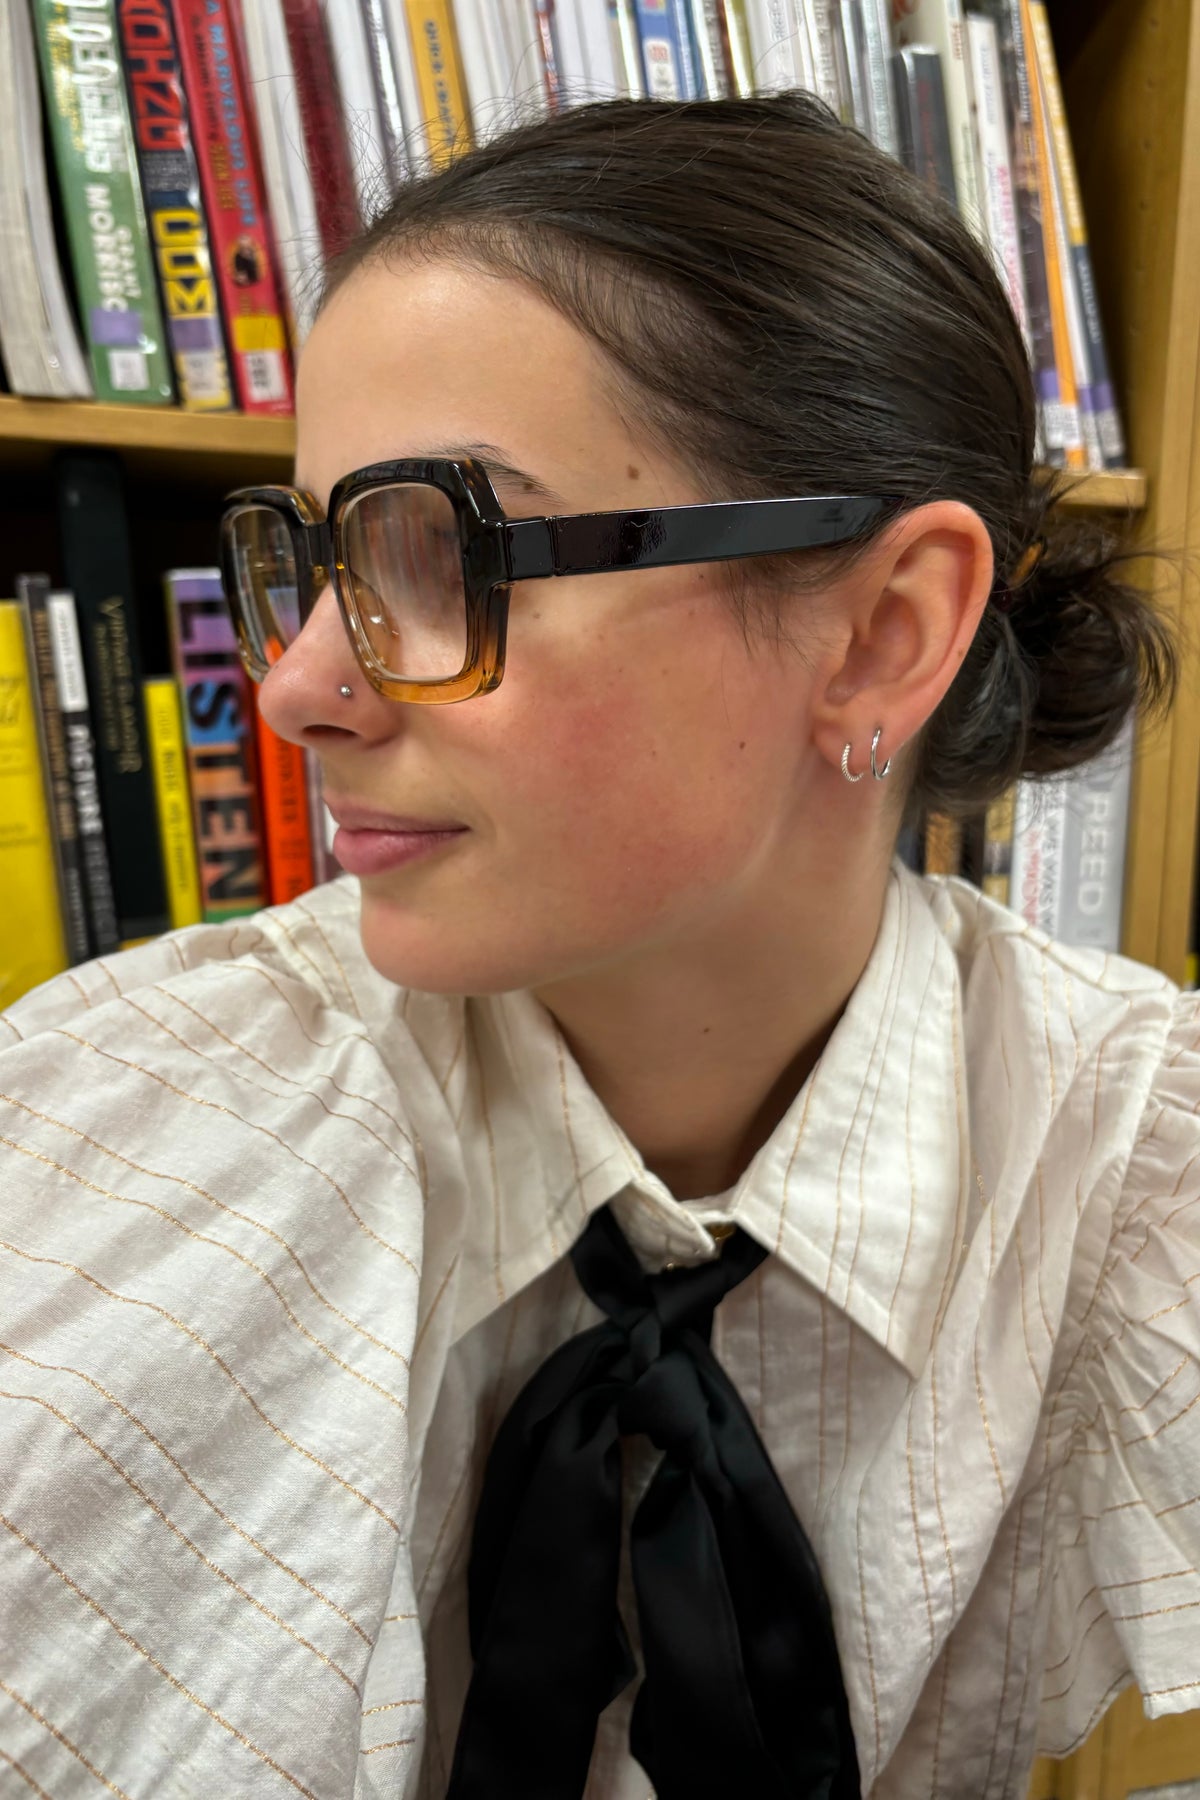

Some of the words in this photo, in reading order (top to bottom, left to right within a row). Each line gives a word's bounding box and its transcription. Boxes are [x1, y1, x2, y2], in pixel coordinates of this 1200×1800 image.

[209, 24, 249, 171] MARVELOUS
[233, 178, 258, 227] LIFE
[84, 183, 128, 313] MORRISO
[115, 225, 142, 299] GRANT
[150, 208, 214, 318] COM
[181, 602, 261, 901] LISTEN
